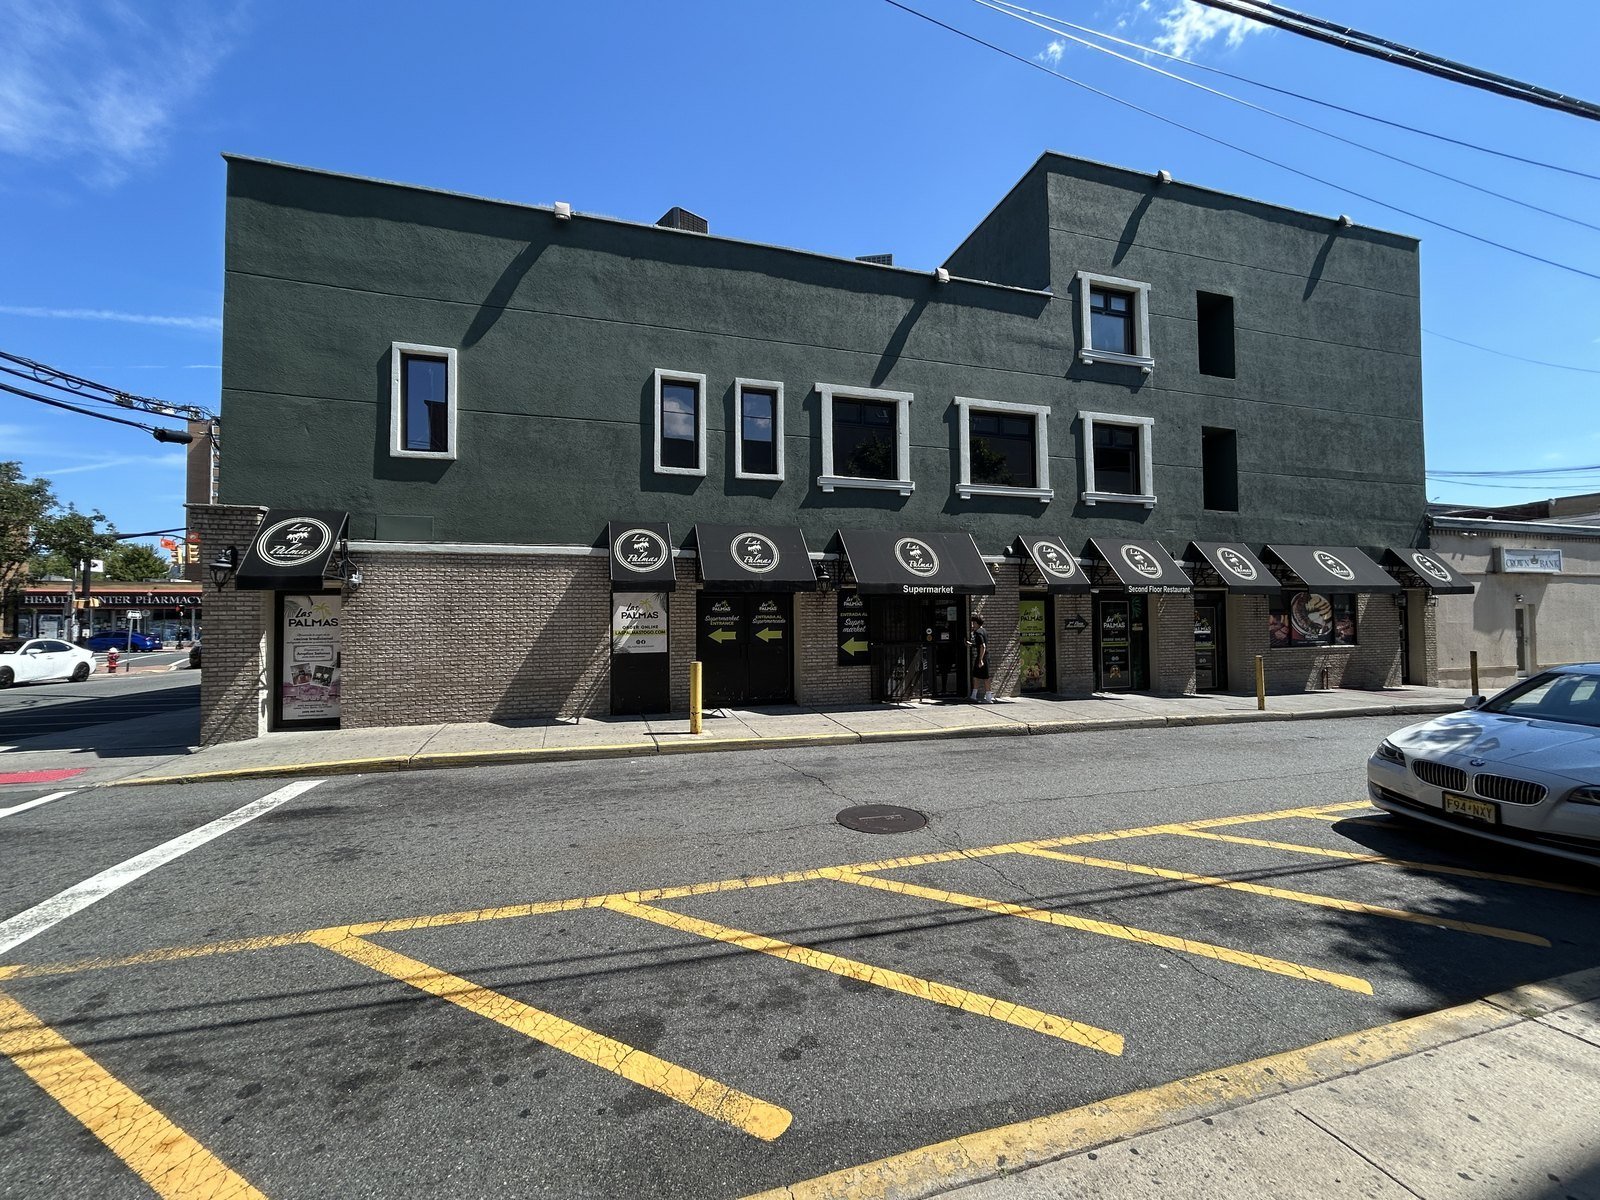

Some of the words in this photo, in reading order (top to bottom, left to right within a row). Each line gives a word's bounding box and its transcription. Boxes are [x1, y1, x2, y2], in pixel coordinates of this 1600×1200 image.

[286, 523, 313, 532] Las
[631, 534, 649, 542] Las
[269, 543, 313, 554] Palmas
[905, 542, 920, 550] Las
[627, 551, 658, 562] Palmas
[743, 554, 772, 563] Palmas
[909, 558, 933, 568] Palmas
[1048, 560, 1070, 569] Palmas
[1540, 559, 1559, 568] BANK
[902, 584, 954, 595] Supermarket
[1128, 585, 1149, 593] Second
[1149, 585, 1163, 593] Floor
[135, 596, 203, 604] PHARMACY
[625, 602, 640, 611] Las
[295, 607, 313, 618] Las
[621, 611, 659, 620] PALMAS
[288, 618, 339, 627] PALMAS
[704, 614, 740, 622] Supermarket
[844, 618, 865, 627] Super
